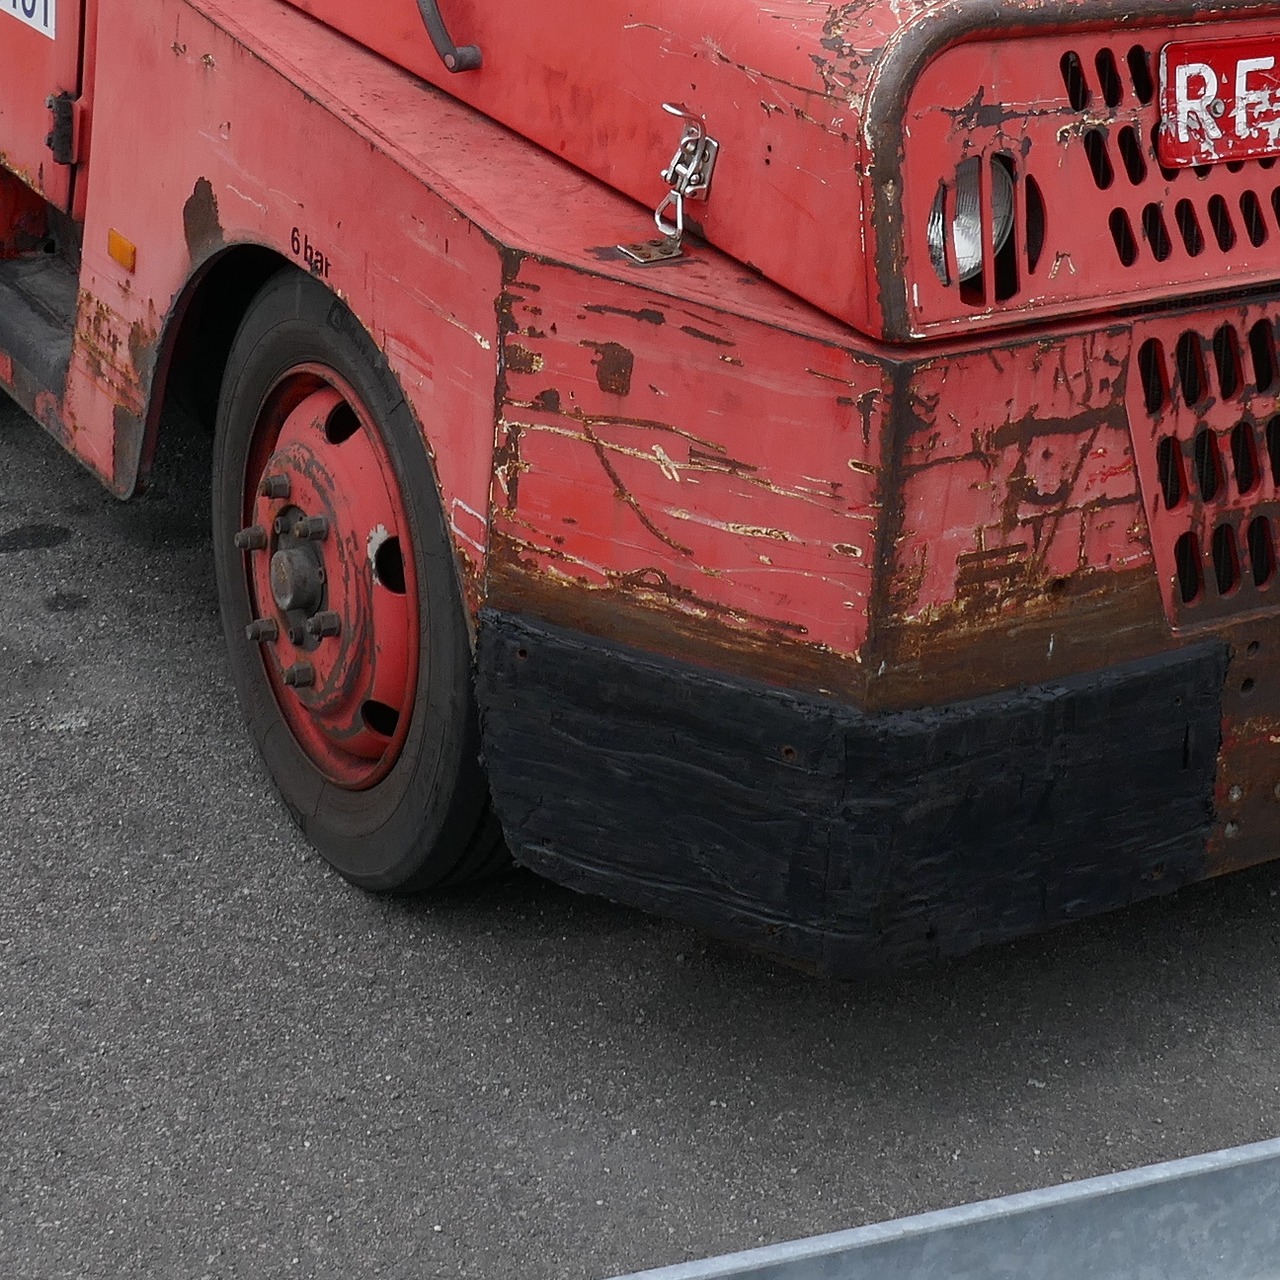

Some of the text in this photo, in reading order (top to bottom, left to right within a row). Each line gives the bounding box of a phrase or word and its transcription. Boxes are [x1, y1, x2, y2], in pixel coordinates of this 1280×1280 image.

[1175, 56, 1275, 144] RF
[291, 226, 332, 278] 6 bar
